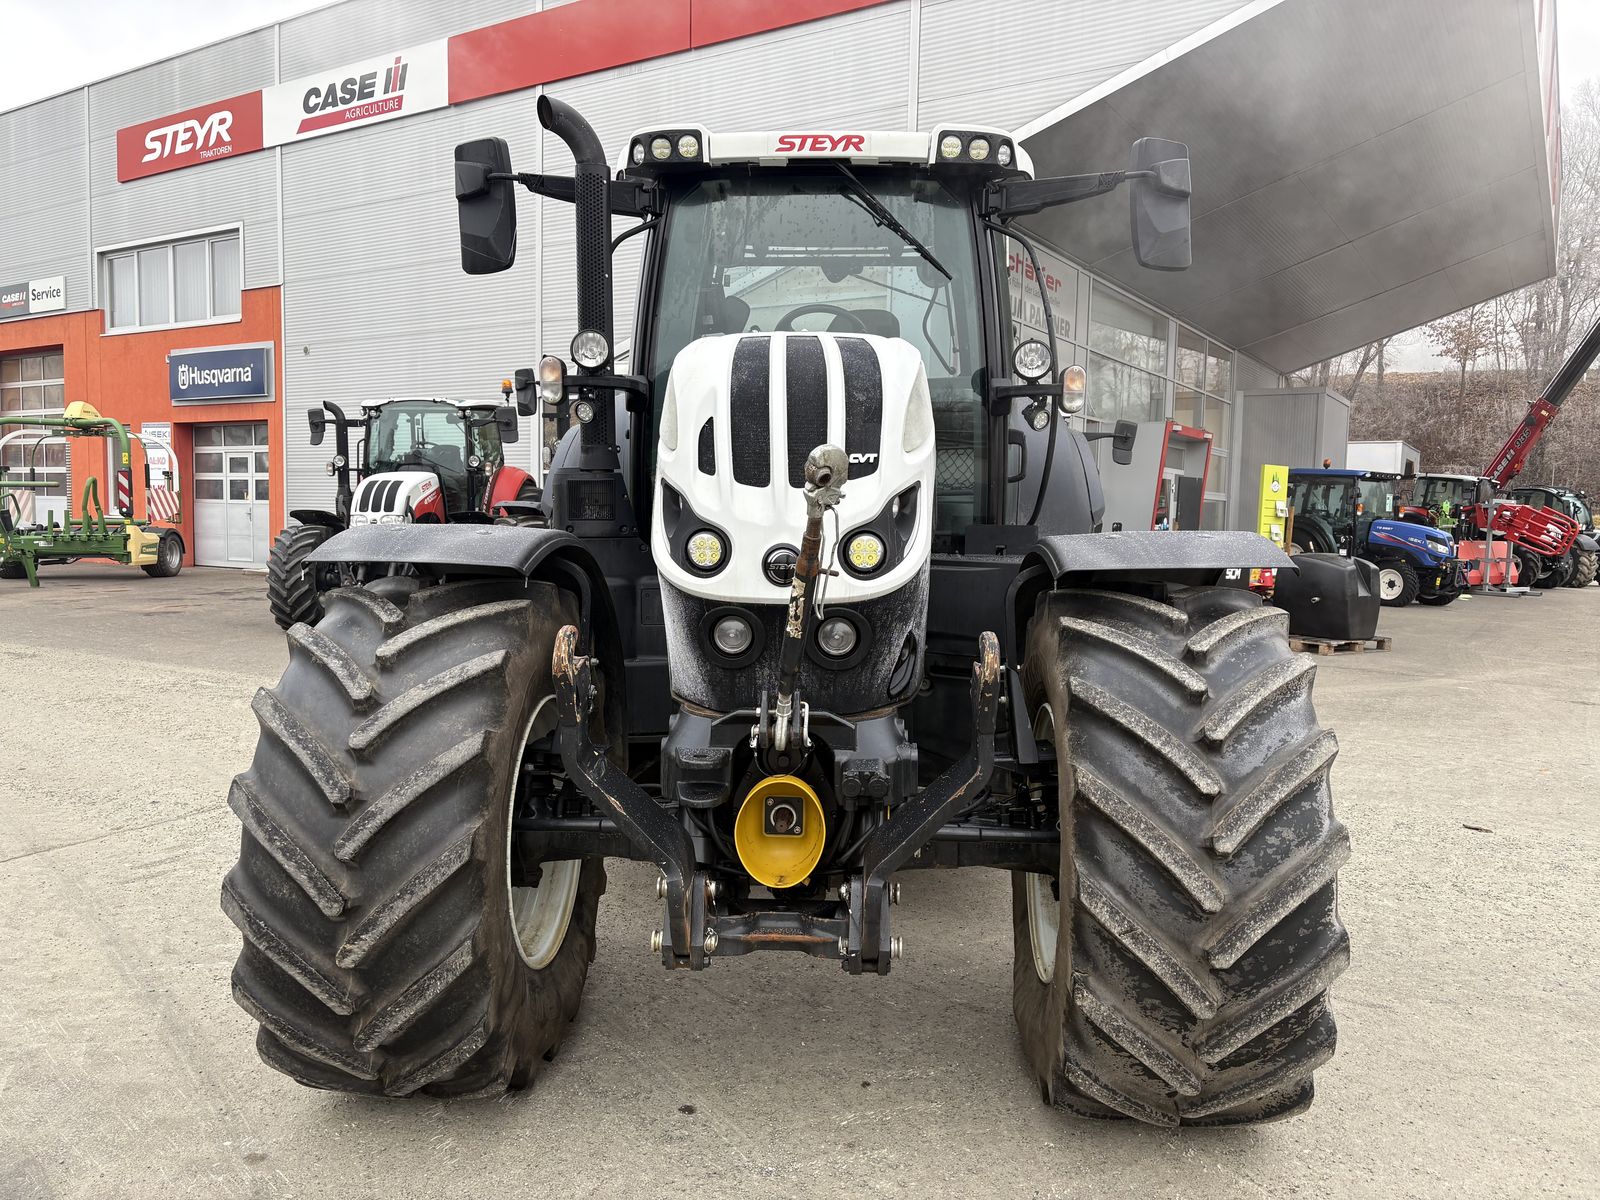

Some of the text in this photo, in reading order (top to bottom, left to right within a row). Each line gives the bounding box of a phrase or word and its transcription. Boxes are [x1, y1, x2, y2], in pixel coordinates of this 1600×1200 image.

[302, 71, 378, 114] CASE
[344, 98, 399, 120] AGRICULTURE
[141, 110, 233, 163] STEYR
[774, 134, 865, 152] STEYR
[199, 145, 233, 159] TRAKTOREN
[2, 292, 20, 304] CASE
[31, 286, 61, 302] Service
[189, 365, 252, 387] Husqvarna
[849, 453, 878, 464] CVT
